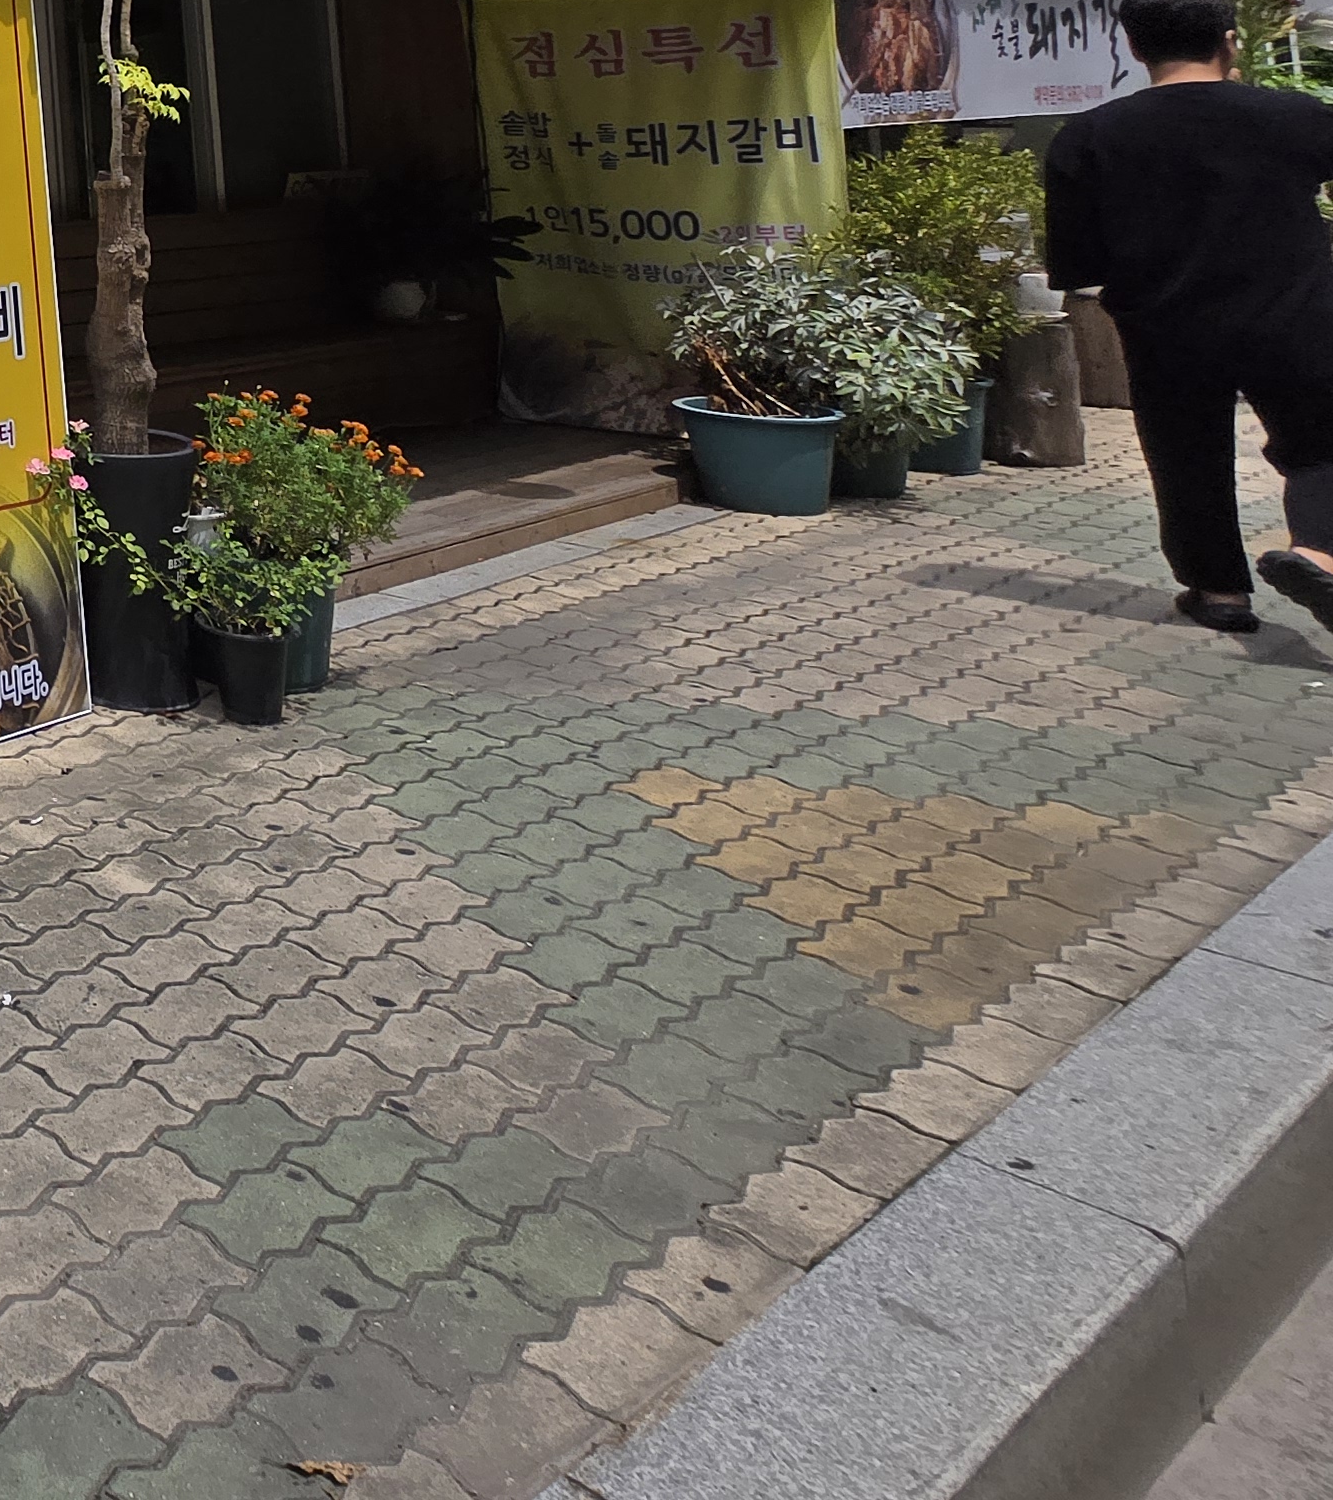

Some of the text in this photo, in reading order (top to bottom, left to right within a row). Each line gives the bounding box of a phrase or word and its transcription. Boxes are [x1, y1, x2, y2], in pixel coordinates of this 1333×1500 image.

[511, 15, 778, 78] 점심특선
[498, 110, 551, 138] 솥밥
[625, 115, 820, 166] 돼지갈비
[504, 145, 554, 173] 정식
